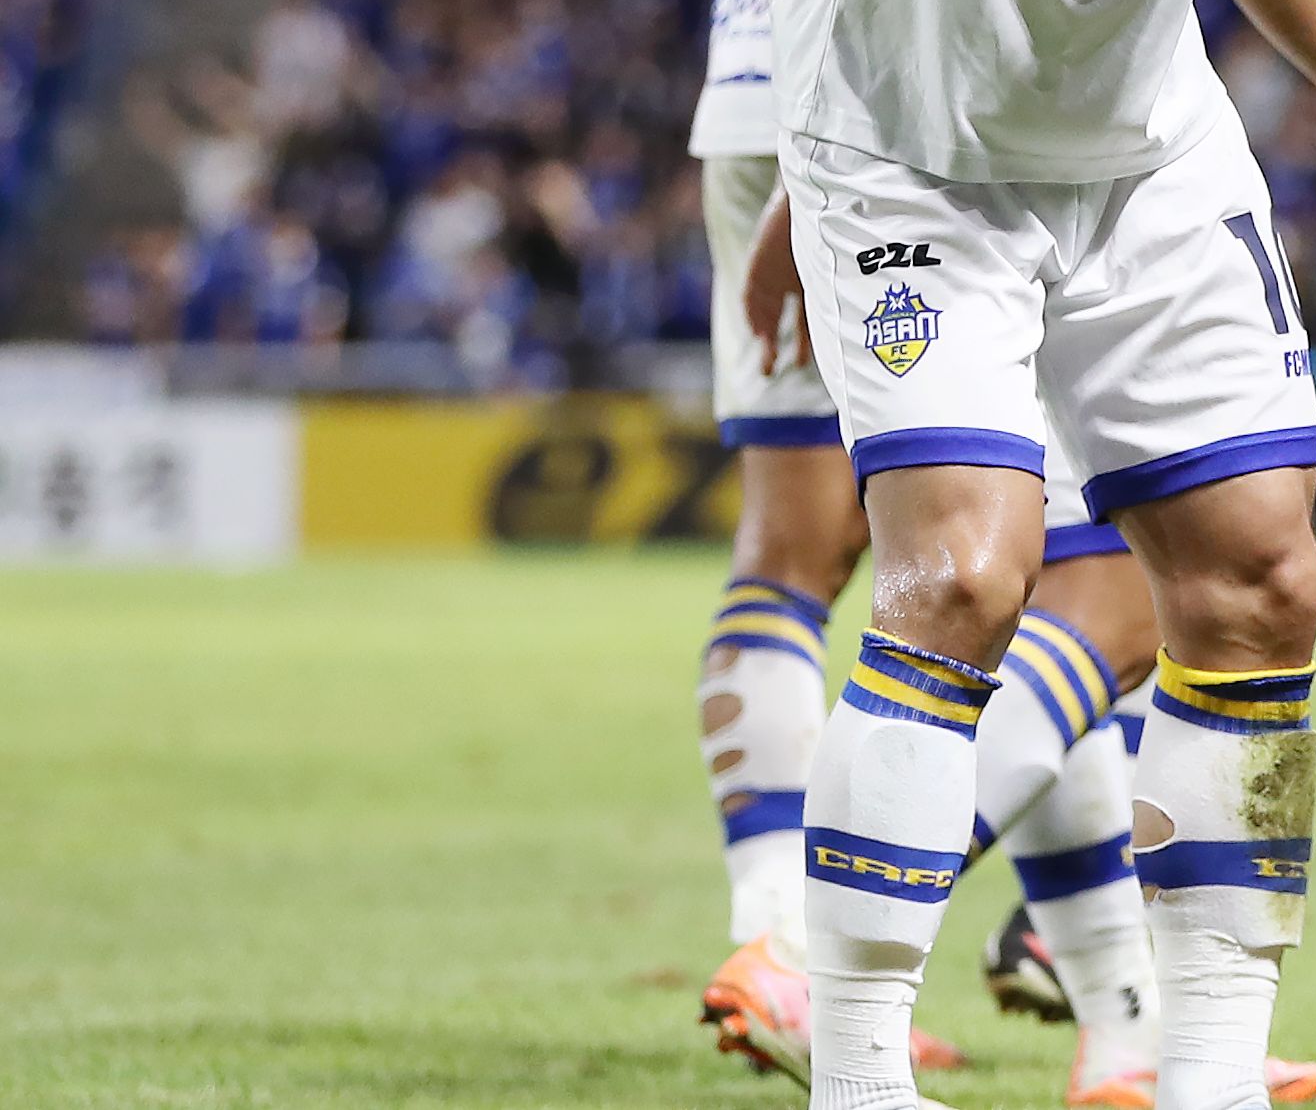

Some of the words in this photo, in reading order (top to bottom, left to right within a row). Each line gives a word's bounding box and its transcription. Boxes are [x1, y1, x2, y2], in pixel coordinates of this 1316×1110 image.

[866, 311, 938, 348] ASAN
[891, 344, 908, 356] FC
[814, 845, 954, 888] CAFC
